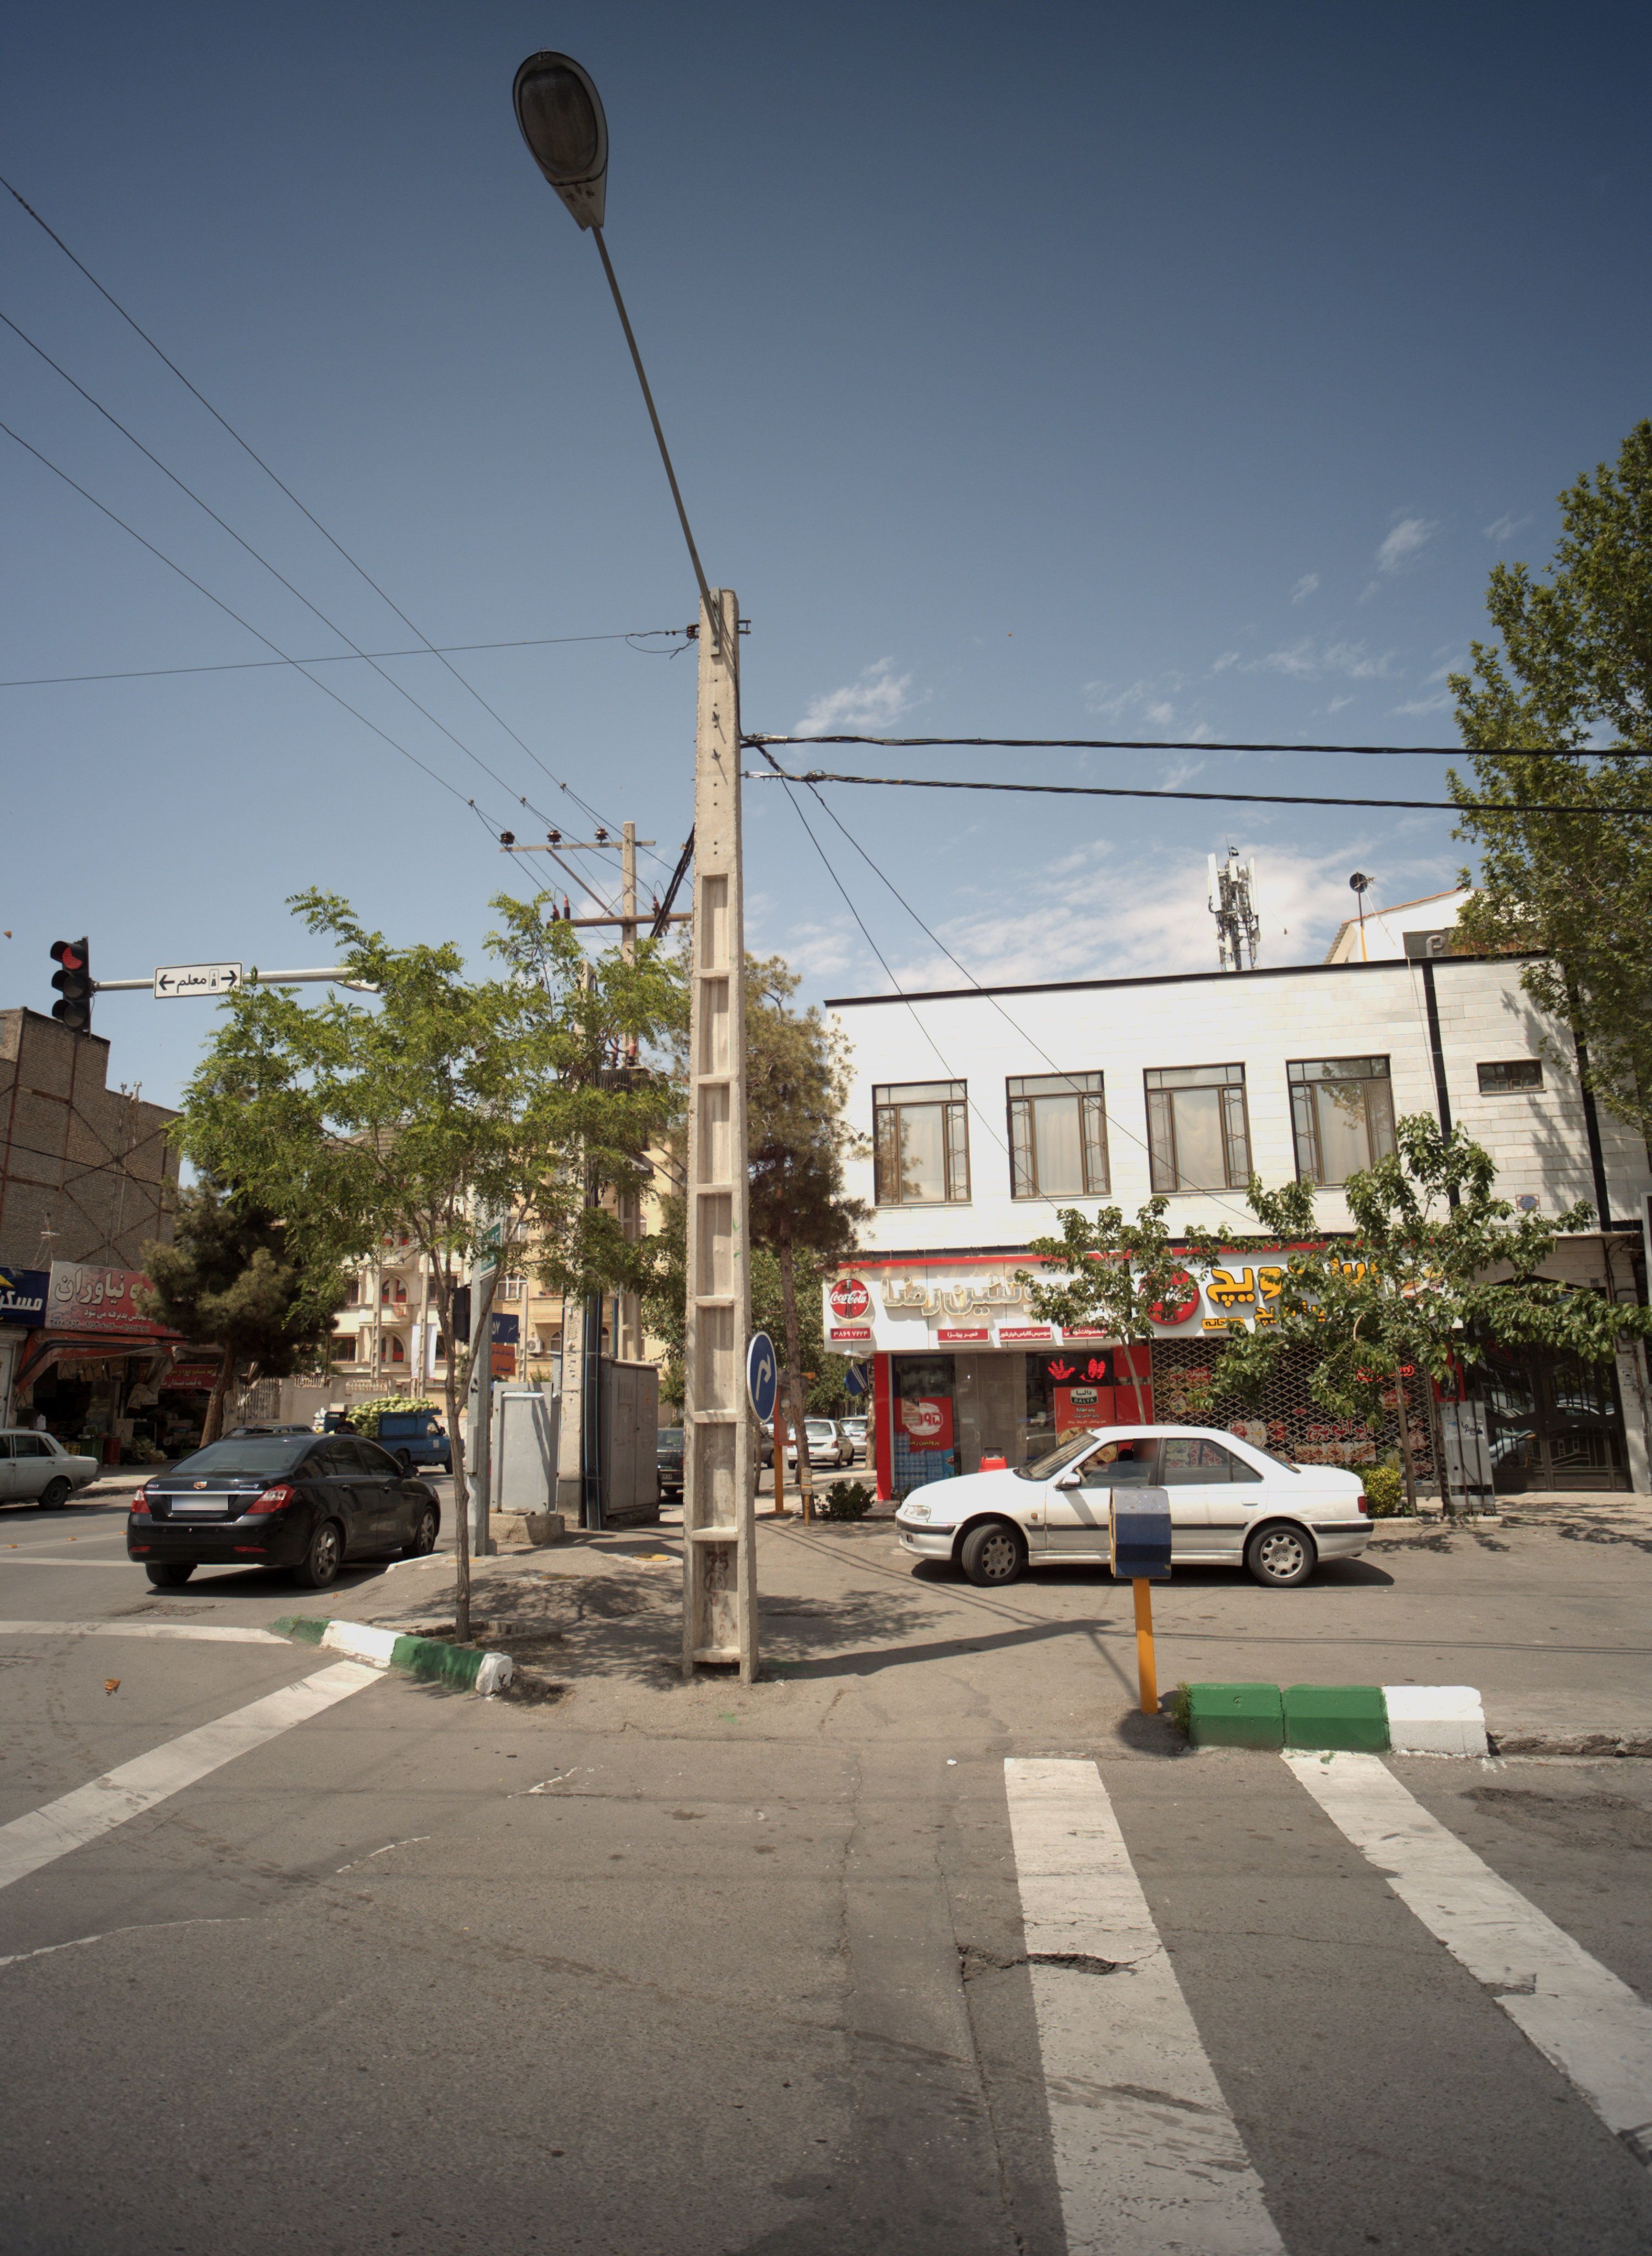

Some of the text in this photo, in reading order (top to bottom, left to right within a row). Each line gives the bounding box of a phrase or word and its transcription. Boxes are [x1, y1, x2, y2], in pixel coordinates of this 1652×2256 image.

[177, 974, 207, 994] معلم
[55, 1268, 126, 1305] نیاوران
[881, 1276, 942, 1316] رضا
